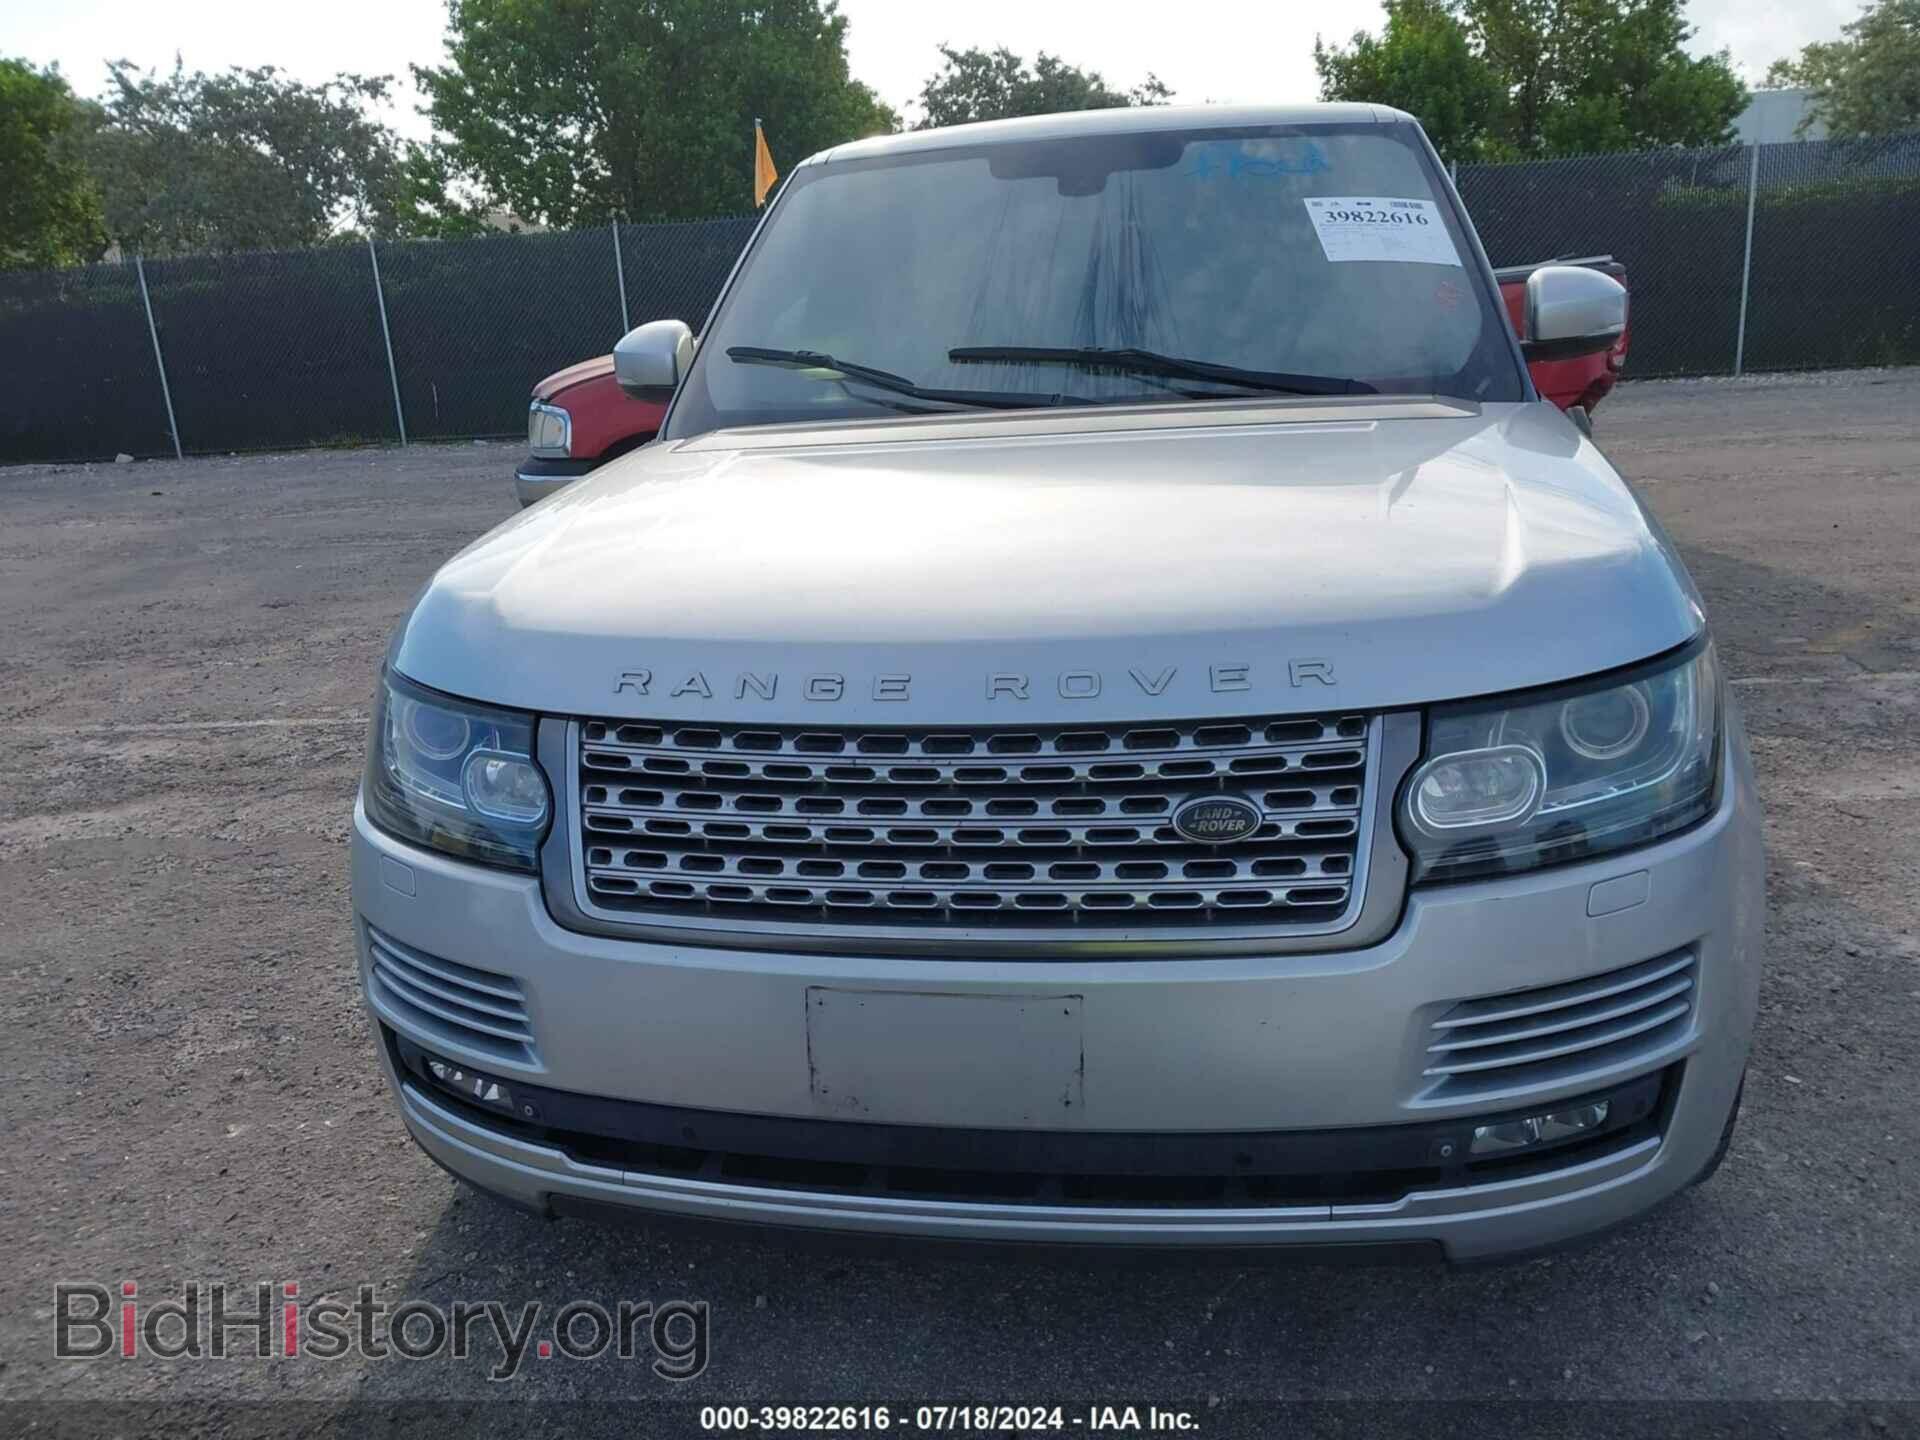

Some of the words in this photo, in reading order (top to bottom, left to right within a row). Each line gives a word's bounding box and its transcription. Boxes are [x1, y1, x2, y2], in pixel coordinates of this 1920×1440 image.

[1325, 210, 1429, 225] 39822616
[613, 667, 912, 701] RANGE
[985, 657, 1337, 700] ROVER
